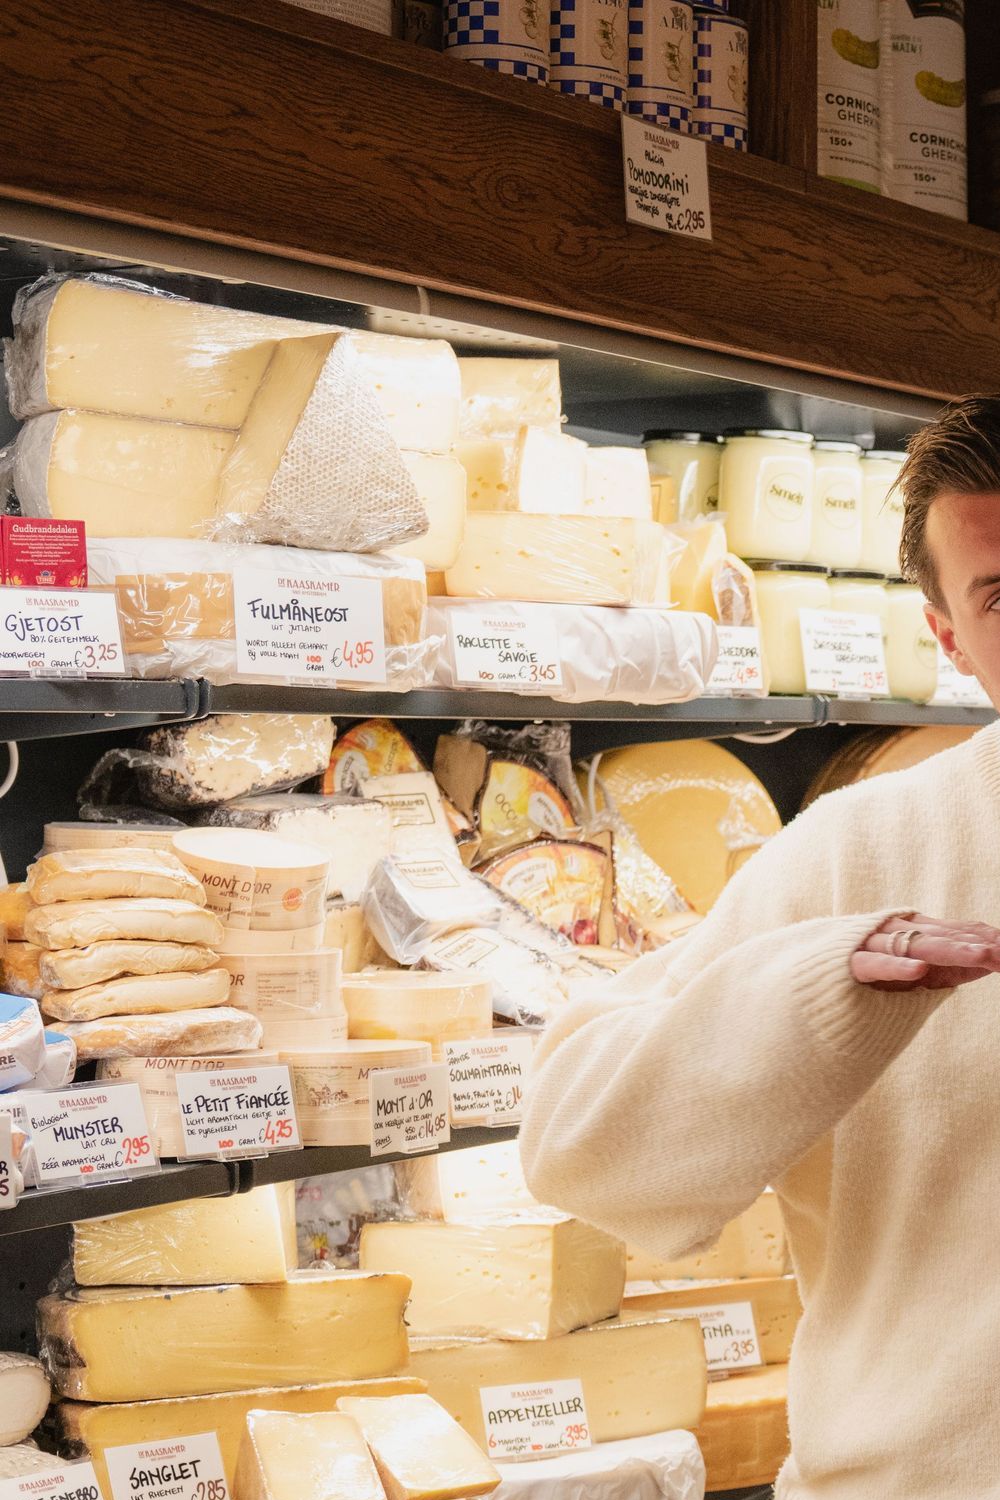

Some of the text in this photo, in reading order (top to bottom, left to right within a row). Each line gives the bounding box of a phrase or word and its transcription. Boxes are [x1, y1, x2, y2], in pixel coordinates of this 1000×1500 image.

[830, 136, 853, 146] 150+
[627, 158, 689, 195] POMODORINI
[914, 173, 936, 182] 150+
[12, 524, 78, 534] Gudbrandsdalen
[286, 578, 340, 592] KAASKAMER
[34, 598, 80, 608] KAASKAMER
[247, 598, 349, 624] FULMÅNEOST
[5, 611, 84, 641] GJETOST
[288, 624, 322, 634] JUTLAND
[30, 635, 100, 644] 80% GEITENMELK
[246, 639, 328, 650] WORDT ALLEEN GEMAAKT
[456, 634, 511, 649] RACLETTE
[260, 650, 300, 660] VOLLE MAAN
[306, 655, 322, 664] 100
[498, 650, 538, 664] SAVOIE
[28, 660, 44, 668] 100
[50, 660, 72, 668] GRAM
[306, 664, 325, 672] GRAM
[478, 670, 494, 680] 100
[201, 873, 272, 894] MONT D'OR
[144, 1058, 186, 1070] MONT
[450, 1062, 522, 1082] SOUMAINTRAIN
[216, 1075, 258, 1086] KAASKAMER
[66, 1095, 108, 1107] KAASKAMER
[182, 1084, 290, 1114] LE PETIT FIANCÉE
[376, 1095, 407, 1116] MONT
[186, 1117, 205, 1126] LICHT
[207, 1113, 249, 1124] AROMATISCH
[53, 1116, 124, 1142] MUNSTER
[81, 1138, 116, 1150] LAIT CRU
[218, 1139, 234, 1149] 100
[238, 1138, 256, 1146] GRAM
[62, 1154, 106, 1167] AROMATISCH
[96, 1162, 114, 1172] GRAM
[488, 1397, 584, 1424] APPENZELLER
[488, 1434, 497, 1448] 6
[145, 1444, 186, 1458] KAASKAMER
[129, 1460, 201, 1490] SANGLET
[25, 1476, 65, 1490] KAASKAMER
[148, 1485, 184, 1500] RHENEN
